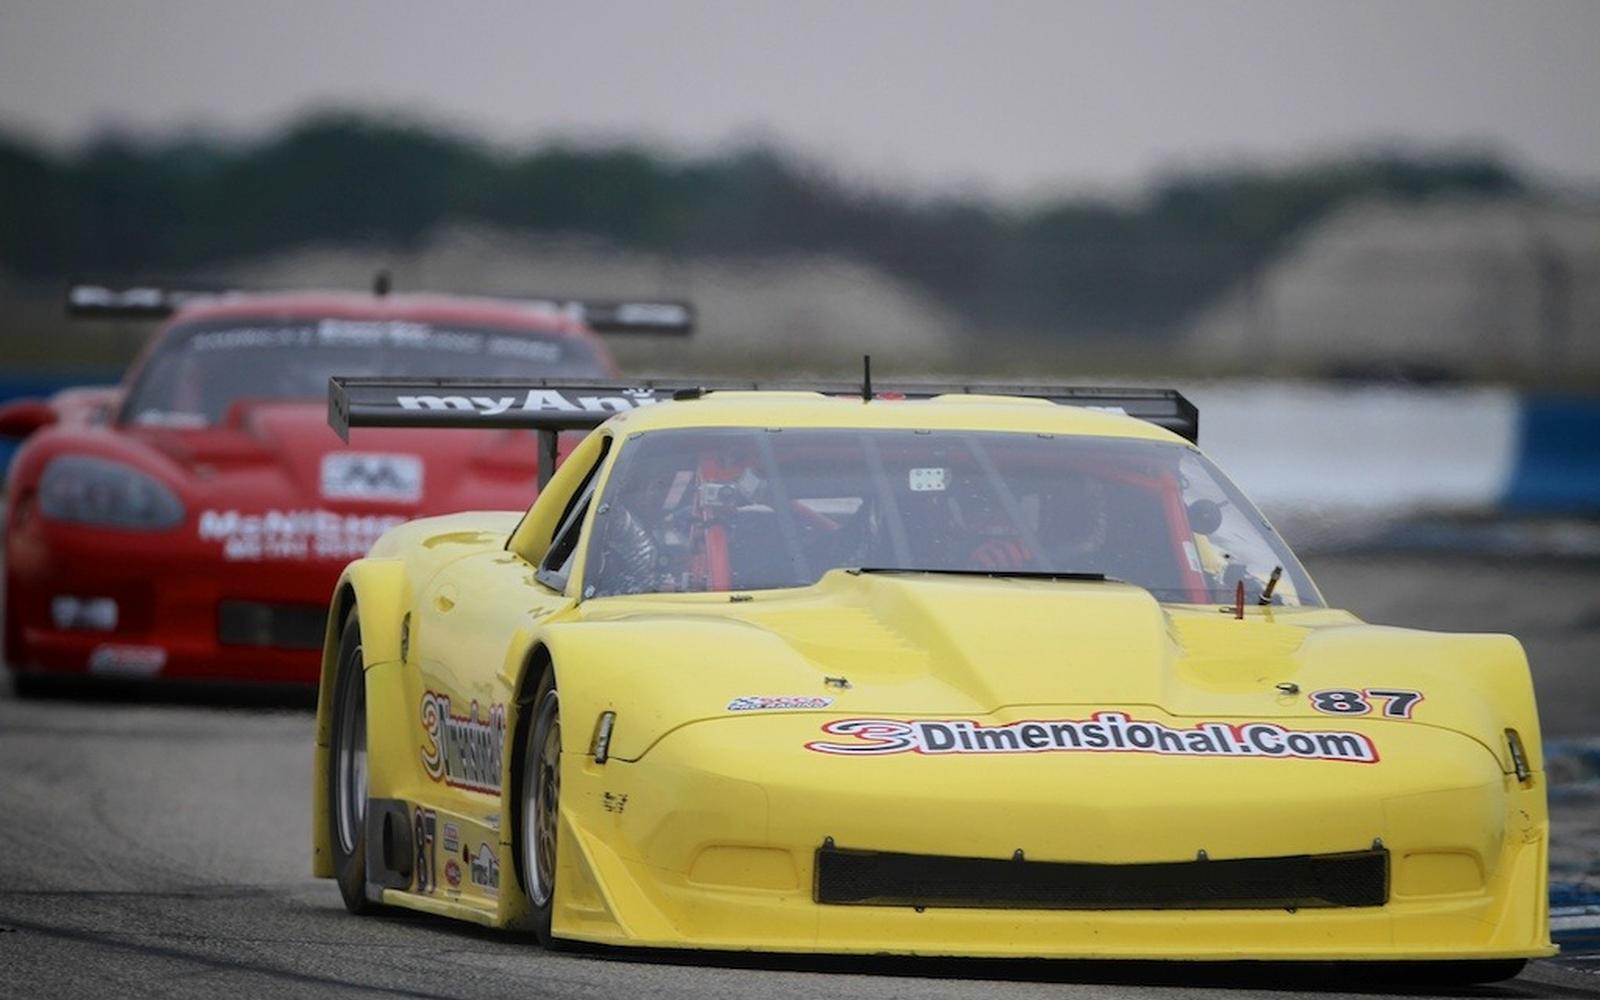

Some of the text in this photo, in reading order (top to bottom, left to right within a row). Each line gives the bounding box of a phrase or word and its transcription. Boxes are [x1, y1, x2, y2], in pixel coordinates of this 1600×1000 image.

[397, 389, 660, 415] myAni
[1310, 688, 1423, 719] 87
[806, 713, 1379, 763] 3Dimensional.Com
[415, 806, 437, 895] 87
